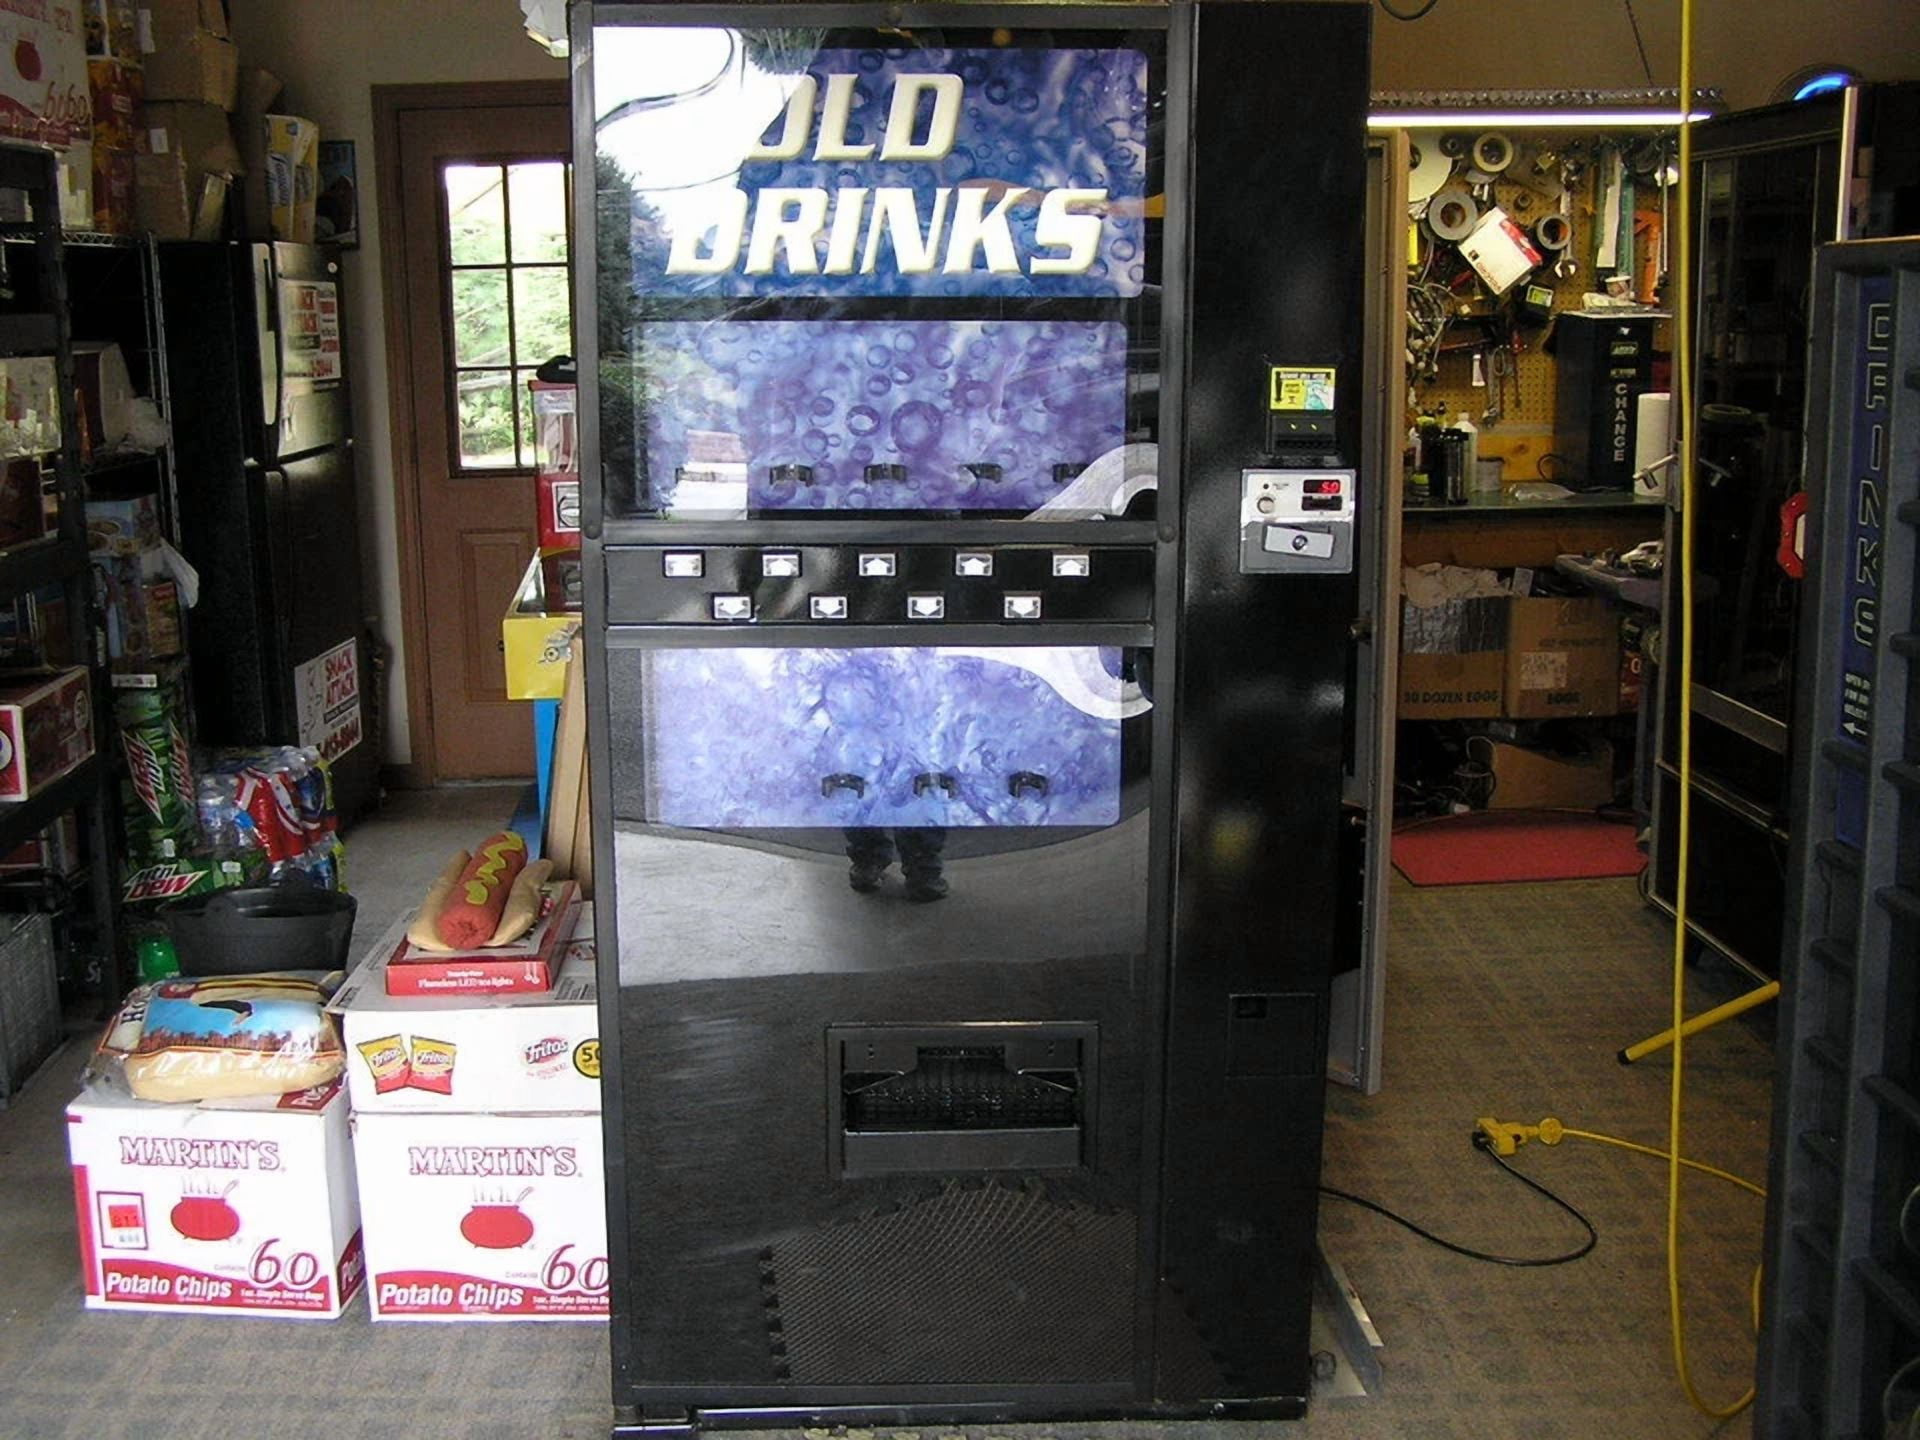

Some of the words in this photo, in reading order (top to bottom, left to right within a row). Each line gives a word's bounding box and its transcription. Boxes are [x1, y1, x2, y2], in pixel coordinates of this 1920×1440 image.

[746, 74, 964, 161] OLD
[665, 188, 1108, 275] DRINKS
[1613, 383, 1628, 462] CHANGE
[1424, 692, 1464, 705] DOZEN
[119, 1136, 280, 1171] MARTIN'S
[408, 1146, 578, 1178] MARTIN'S
[249, 1238, 319, 1287] 60
[542, 1243, 609, 1291] 60
[106, 1273, 170, 1296] Potato
[175, 1275, 232, 1301] Chips
[380, 1283, 453, 1307] Potato
[458, 1282, 524, 1310] Chips
